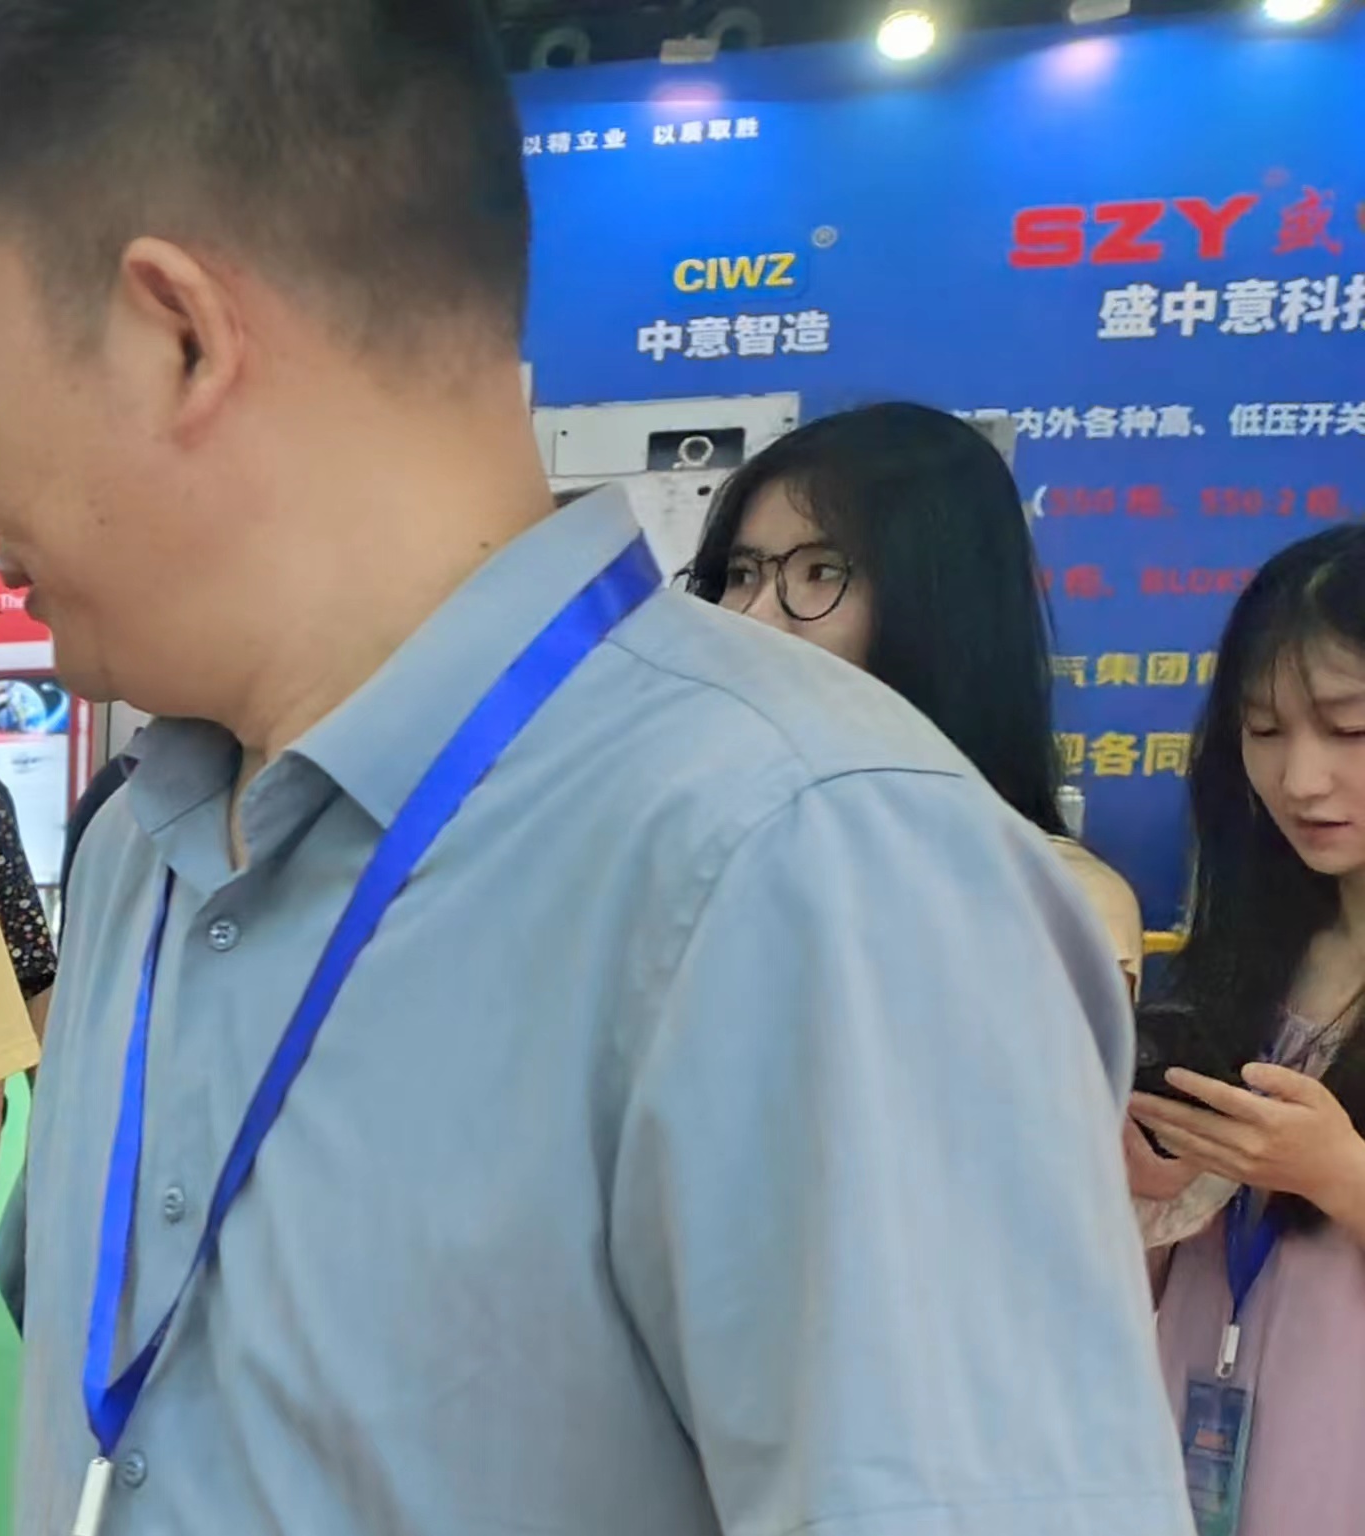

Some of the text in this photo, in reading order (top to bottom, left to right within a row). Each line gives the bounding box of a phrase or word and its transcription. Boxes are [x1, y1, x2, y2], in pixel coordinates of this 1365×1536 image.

[653, 116, 759, 145] 以质取胜
[1007, 193, 1261, 269] SZY
[673, 252, 796, 293] CIWZ
[637, 308, 831, 362] 中意智造
[951, 402, 1365, 440] 内外各种高、低压开关
